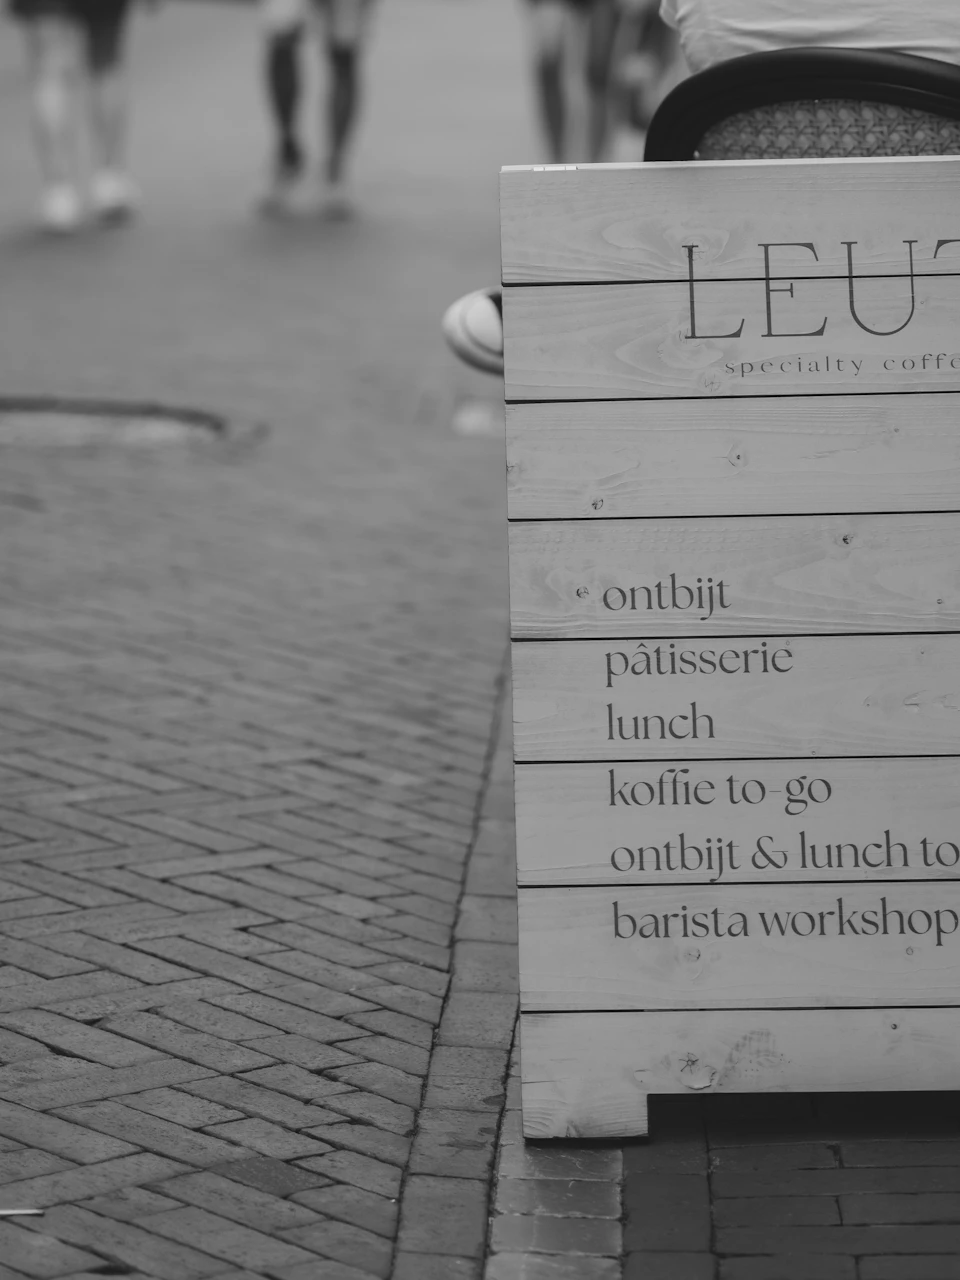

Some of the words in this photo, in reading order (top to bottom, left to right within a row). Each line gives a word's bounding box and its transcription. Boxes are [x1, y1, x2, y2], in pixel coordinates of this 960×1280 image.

[724, 355, 863, 377] specialty
[602, 573, 732, 621] ontbijt
[605, 642, 793, 687] pâtisserie
[606, 702, 715, 740] lunch
[608, 768, 715, 806] koffie
[726, 775, 833, 816] to-go
[610, 833, 741, 882] ontbijt
[751, 835, 789, 870] &
[799, 829, 909, 868] lunch
[612, 901, 749, 939] barista
